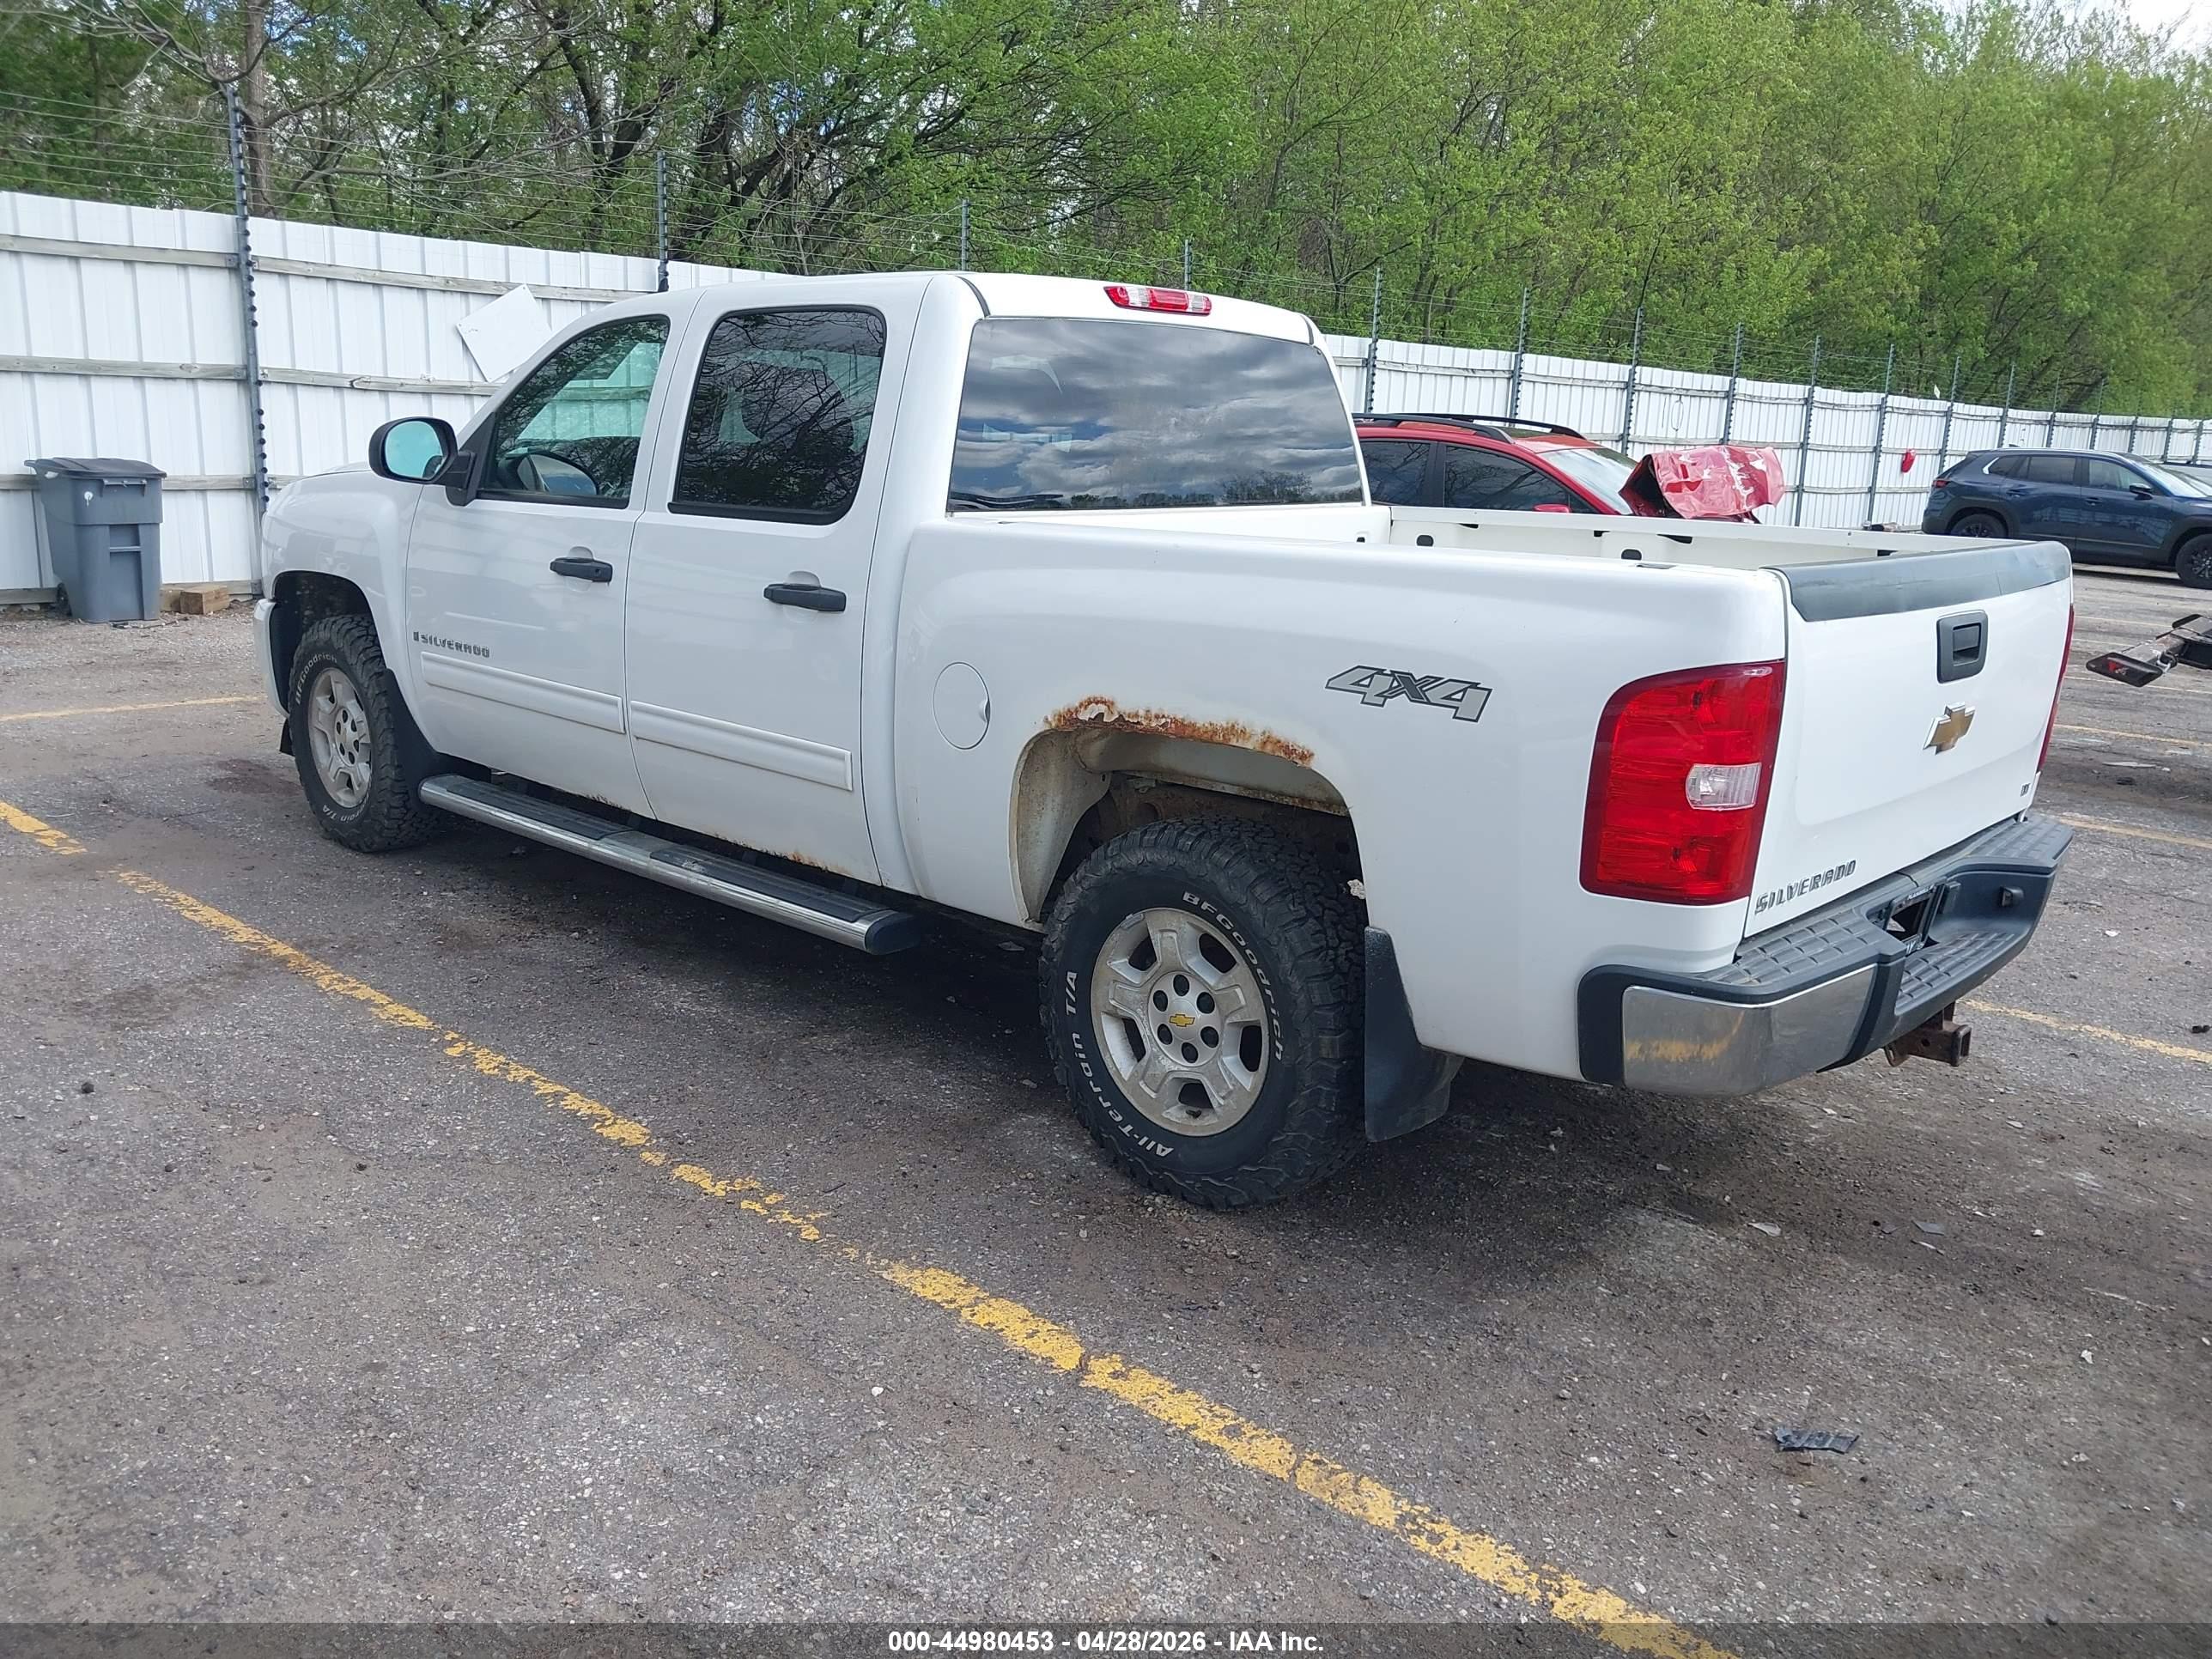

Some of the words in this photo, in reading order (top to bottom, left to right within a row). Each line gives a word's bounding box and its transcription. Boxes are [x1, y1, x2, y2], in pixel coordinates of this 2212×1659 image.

[1753, 860, 1857, 915] SILVERADO
[1065, 970, 1079, 1017] T/A
[1182, 890, 1285, 1061] BFGoodrich
[1071, 1032, 1175, 1158] All-Terrain
